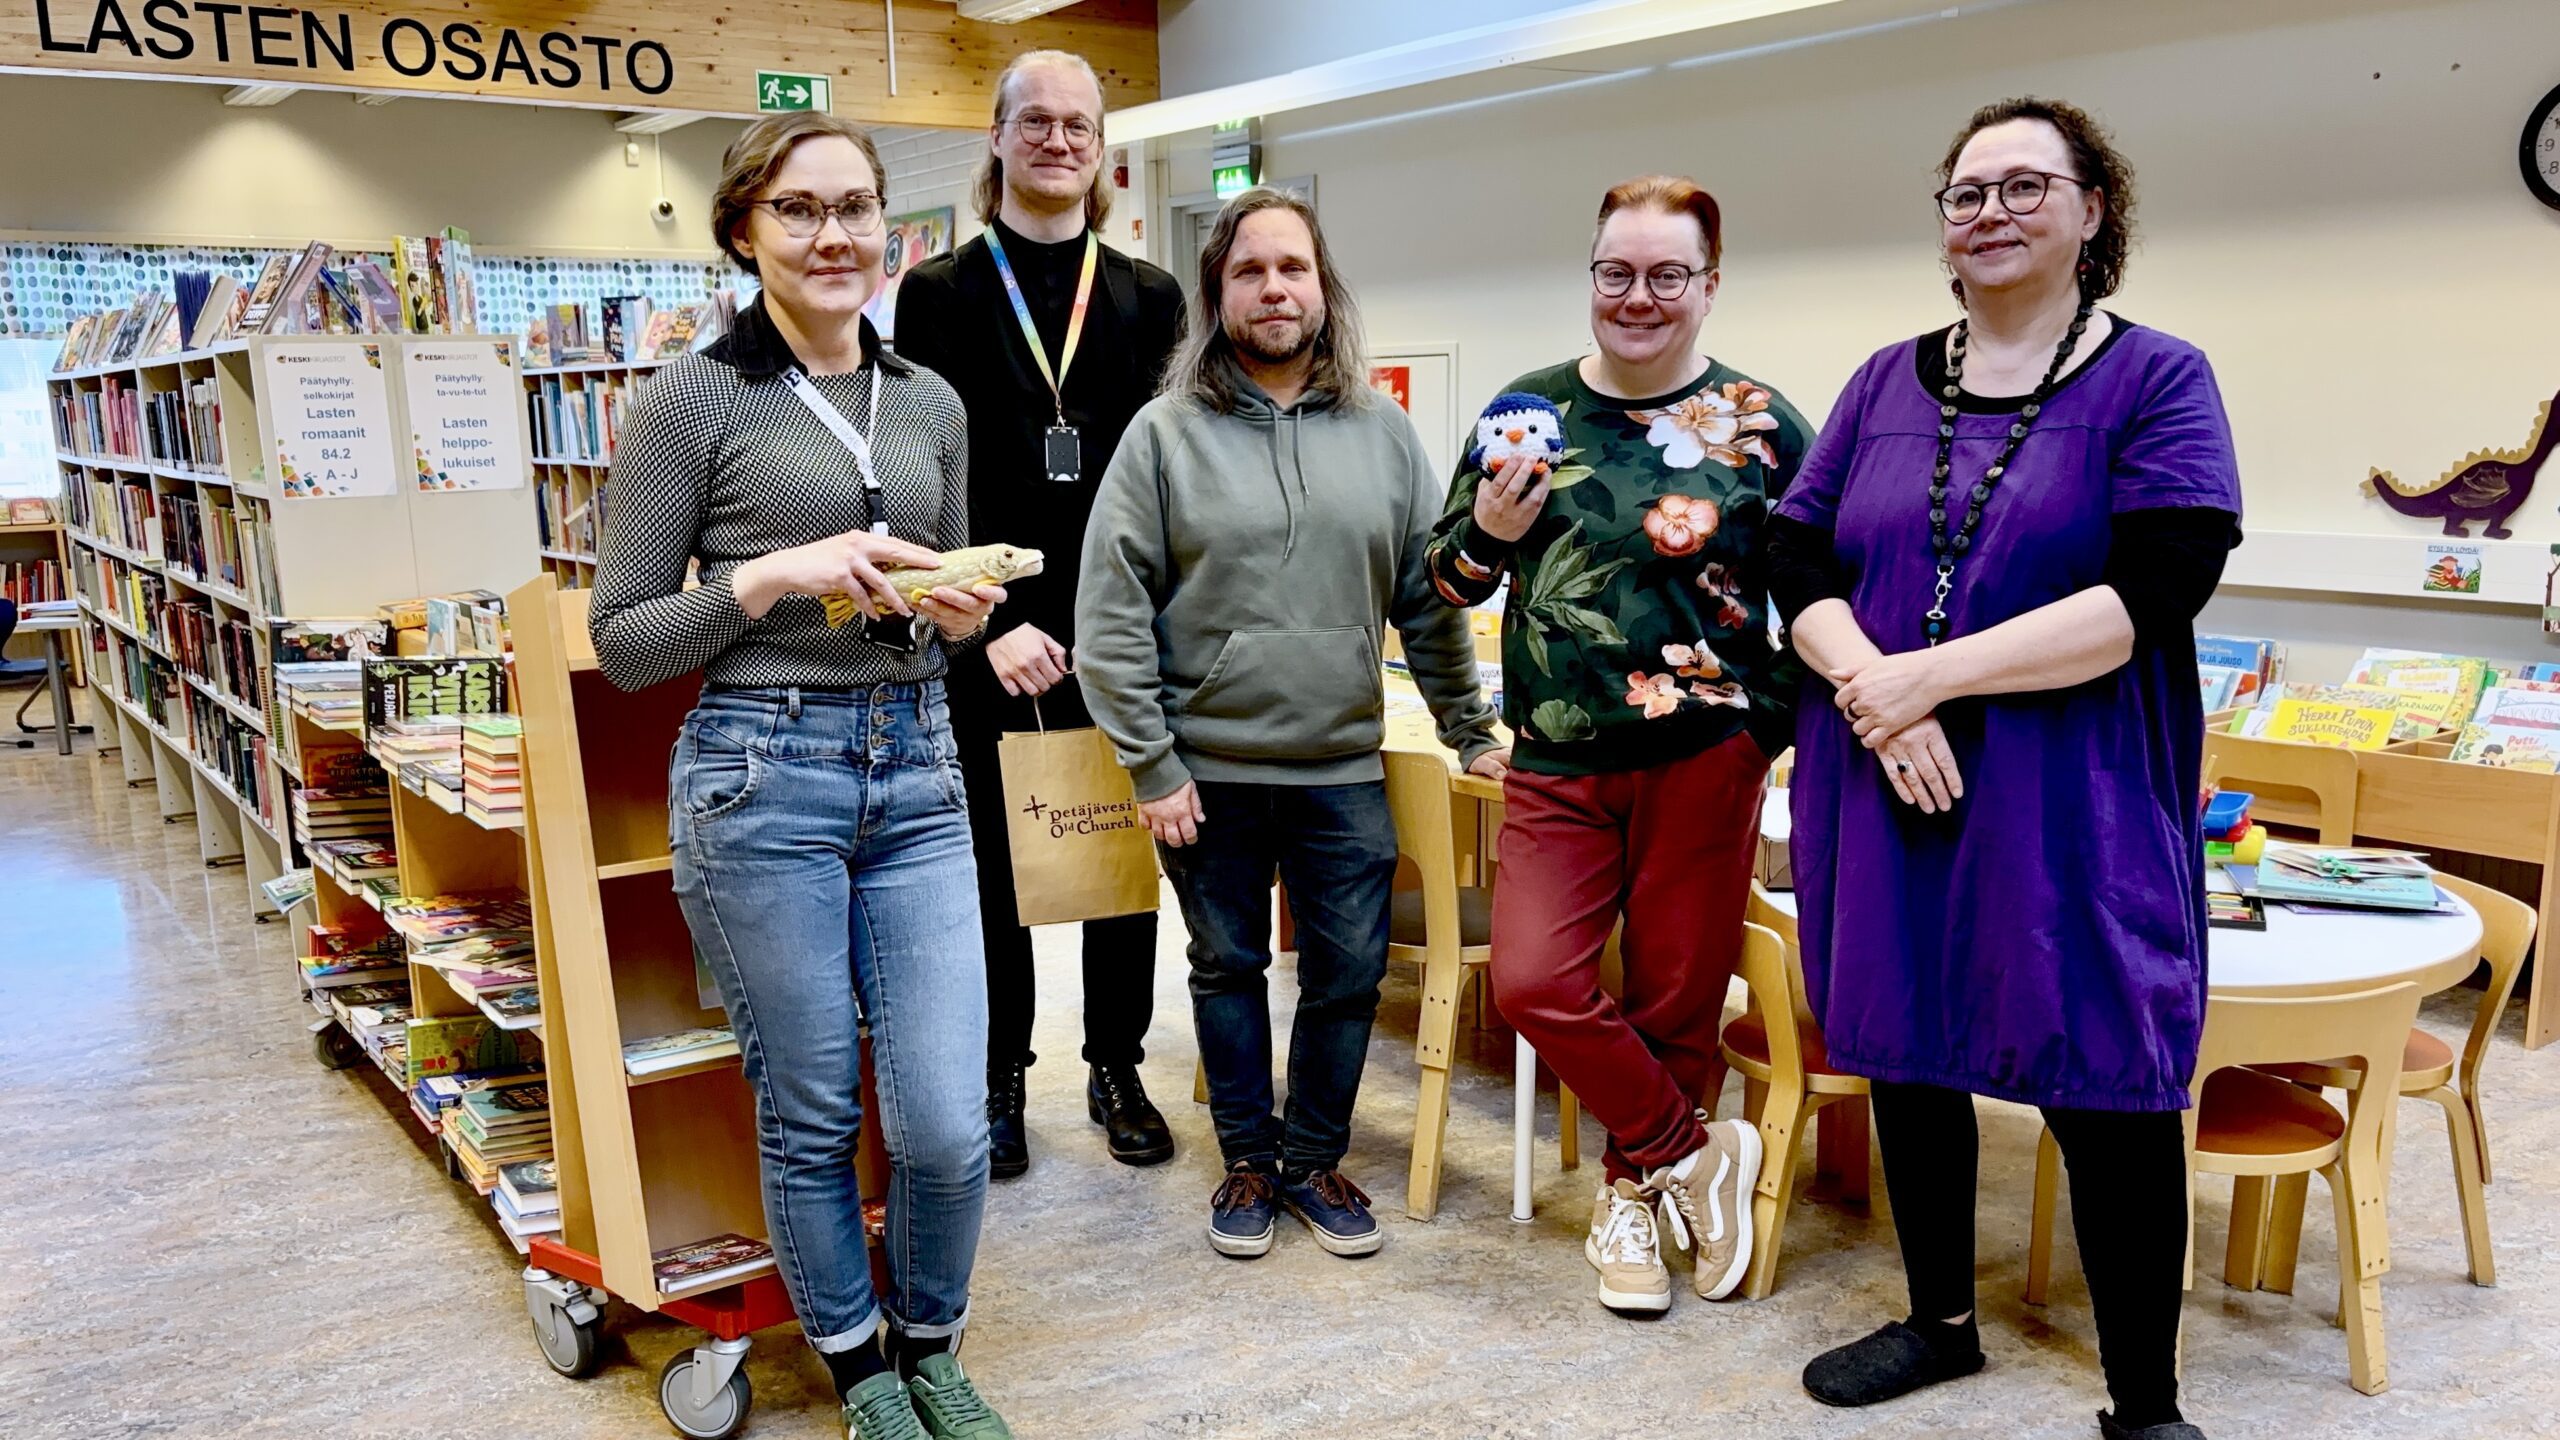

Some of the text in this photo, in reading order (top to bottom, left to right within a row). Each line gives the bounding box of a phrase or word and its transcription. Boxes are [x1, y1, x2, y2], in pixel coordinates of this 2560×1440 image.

[36, 0, 674, 95] LASTEN OSASTO
[2545, 138, 2555, 152] 9
[2549, 160, 2560, 174] 8
[299, 376, 354, 387] Päätyhylly:
[303, 391, 355, 401] selkokirjat
[436, 387, 487, 397] ta-vu-te-tut
[306, 407, 356, 419] Lasten
[442, 417, 488, 429] Lasten
[301, 426, 367, 440] romaanit
[441, 437, 493, 451] helppo-
[321, 447, 352, 460] 84.2
[442, 456, 496, 469] lukuiset
[325, 468, 337, 481] A
[350, 468, 359, 480] J
[2427, 544, 2444, 553] ETSI
[2446, 545, 2454, 553] JA
[2206, 655, 2217, 663] JA
[2219, 655, 2243, 666] JUUSO
[1048, 798, 1133, 825] petäjävesi
[1050, 815, 1135, 839] Old Church
